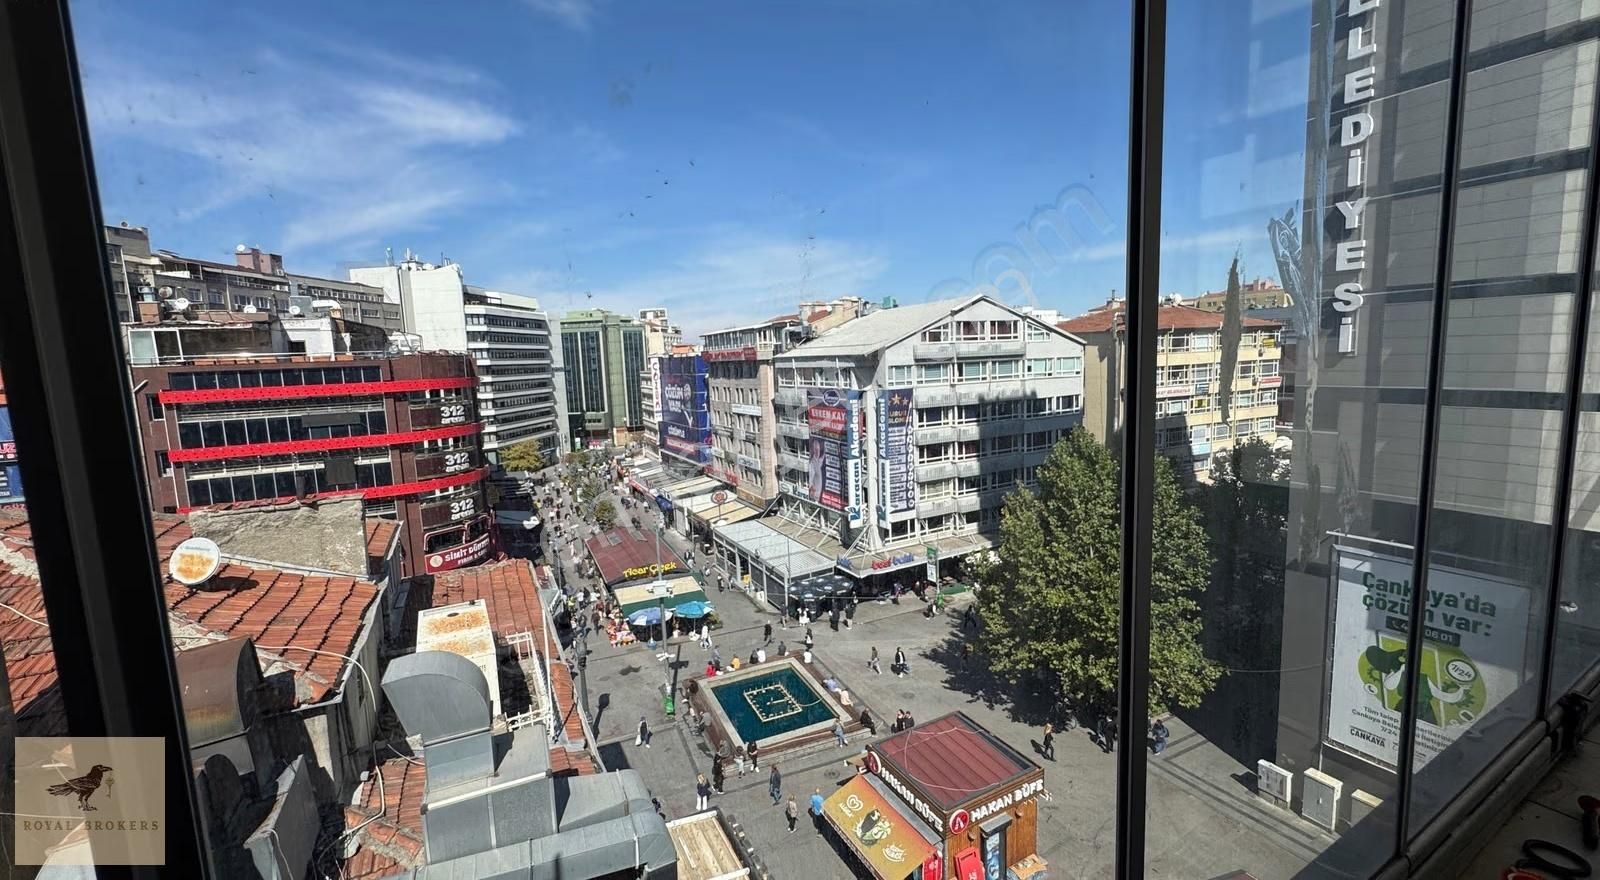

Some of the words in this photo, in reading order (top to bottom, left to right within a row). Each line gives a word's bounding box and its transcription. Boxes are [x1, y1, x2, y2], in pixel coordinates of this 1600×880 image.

[440, 405, 464, 417] 312
[850, 399, 860, 457] Akademi
[878, 398, 886, 457] Akademi
[445, 452, 469, 465] 312
[450, 498, 474, 512] 312
[648, 560, 677, 575] Ççek
[1362, 571, 1497, 617] Çankya'da
[968, 795, 1014, 824] HAKAN
[1014, 778, 1044, 803] BÜFE
